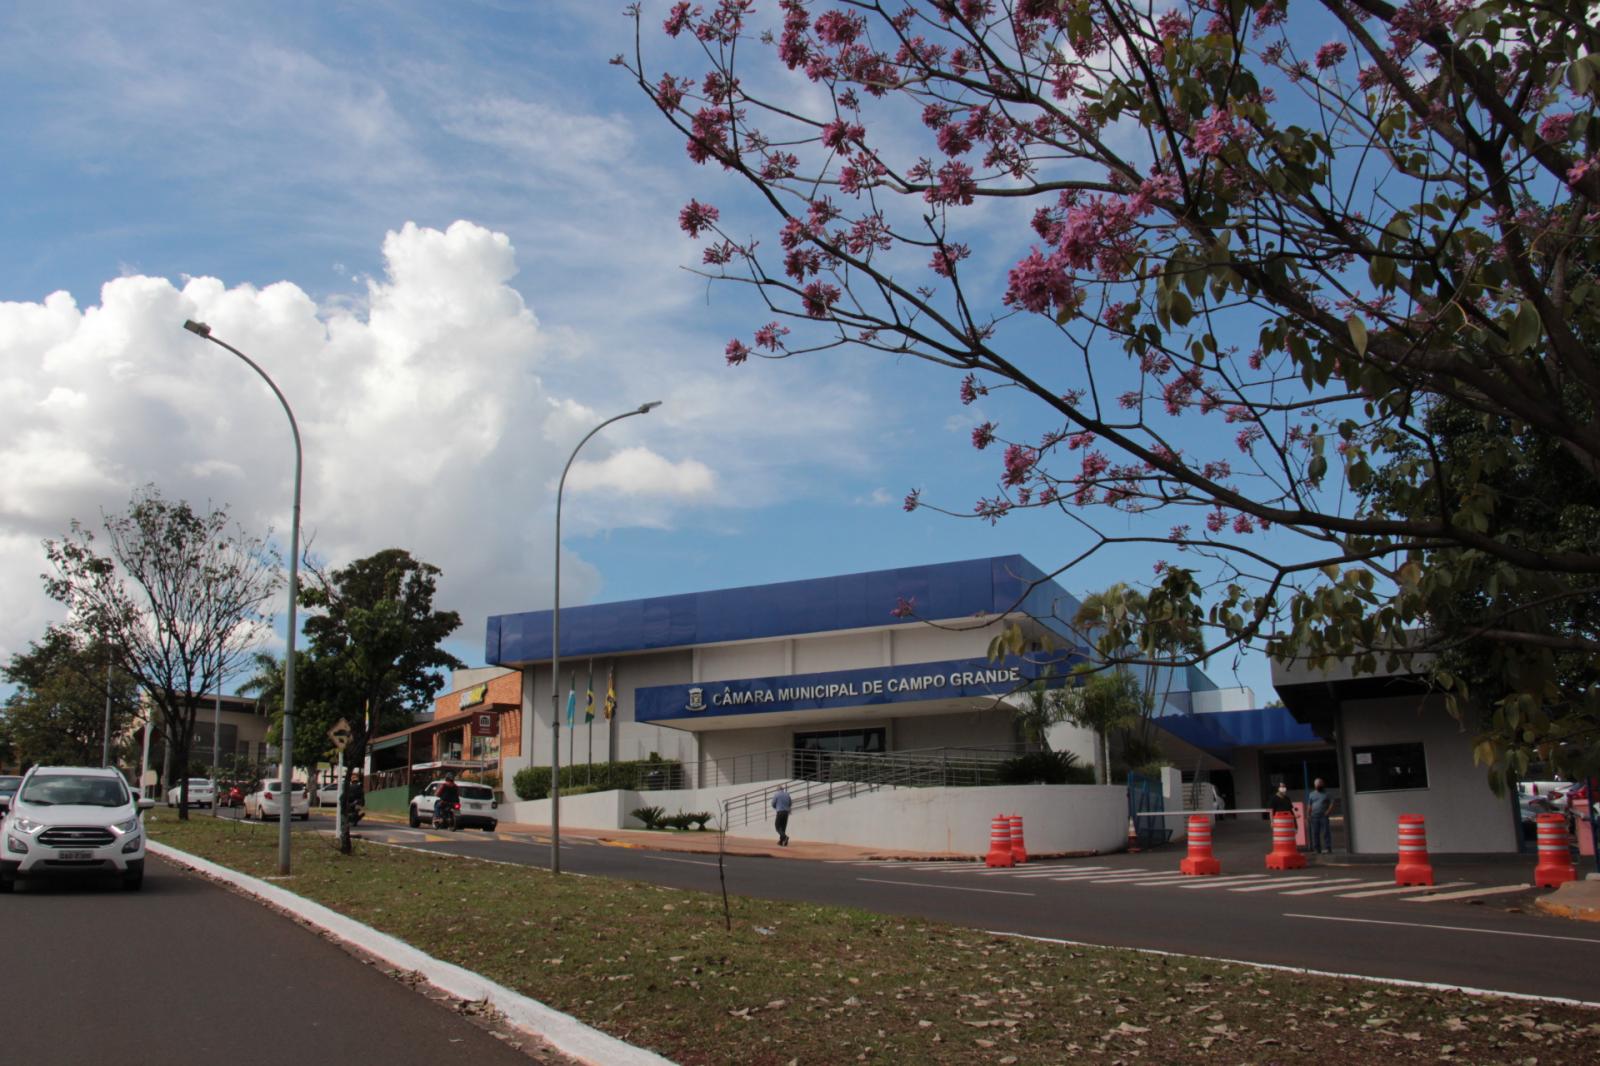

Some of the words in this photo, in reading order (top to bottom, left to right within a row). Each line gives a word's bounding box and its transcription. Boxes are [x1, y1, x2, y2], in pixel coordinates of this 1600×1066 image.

[712, 686, 775, 706] CÂMARA
[778, 682, 858, 701] MUNICIPAL
[863, 680, 883, 695] DE
[887, 674, 945, 693] CAMPO
[950, 667, 1021, 686] GRANDE
